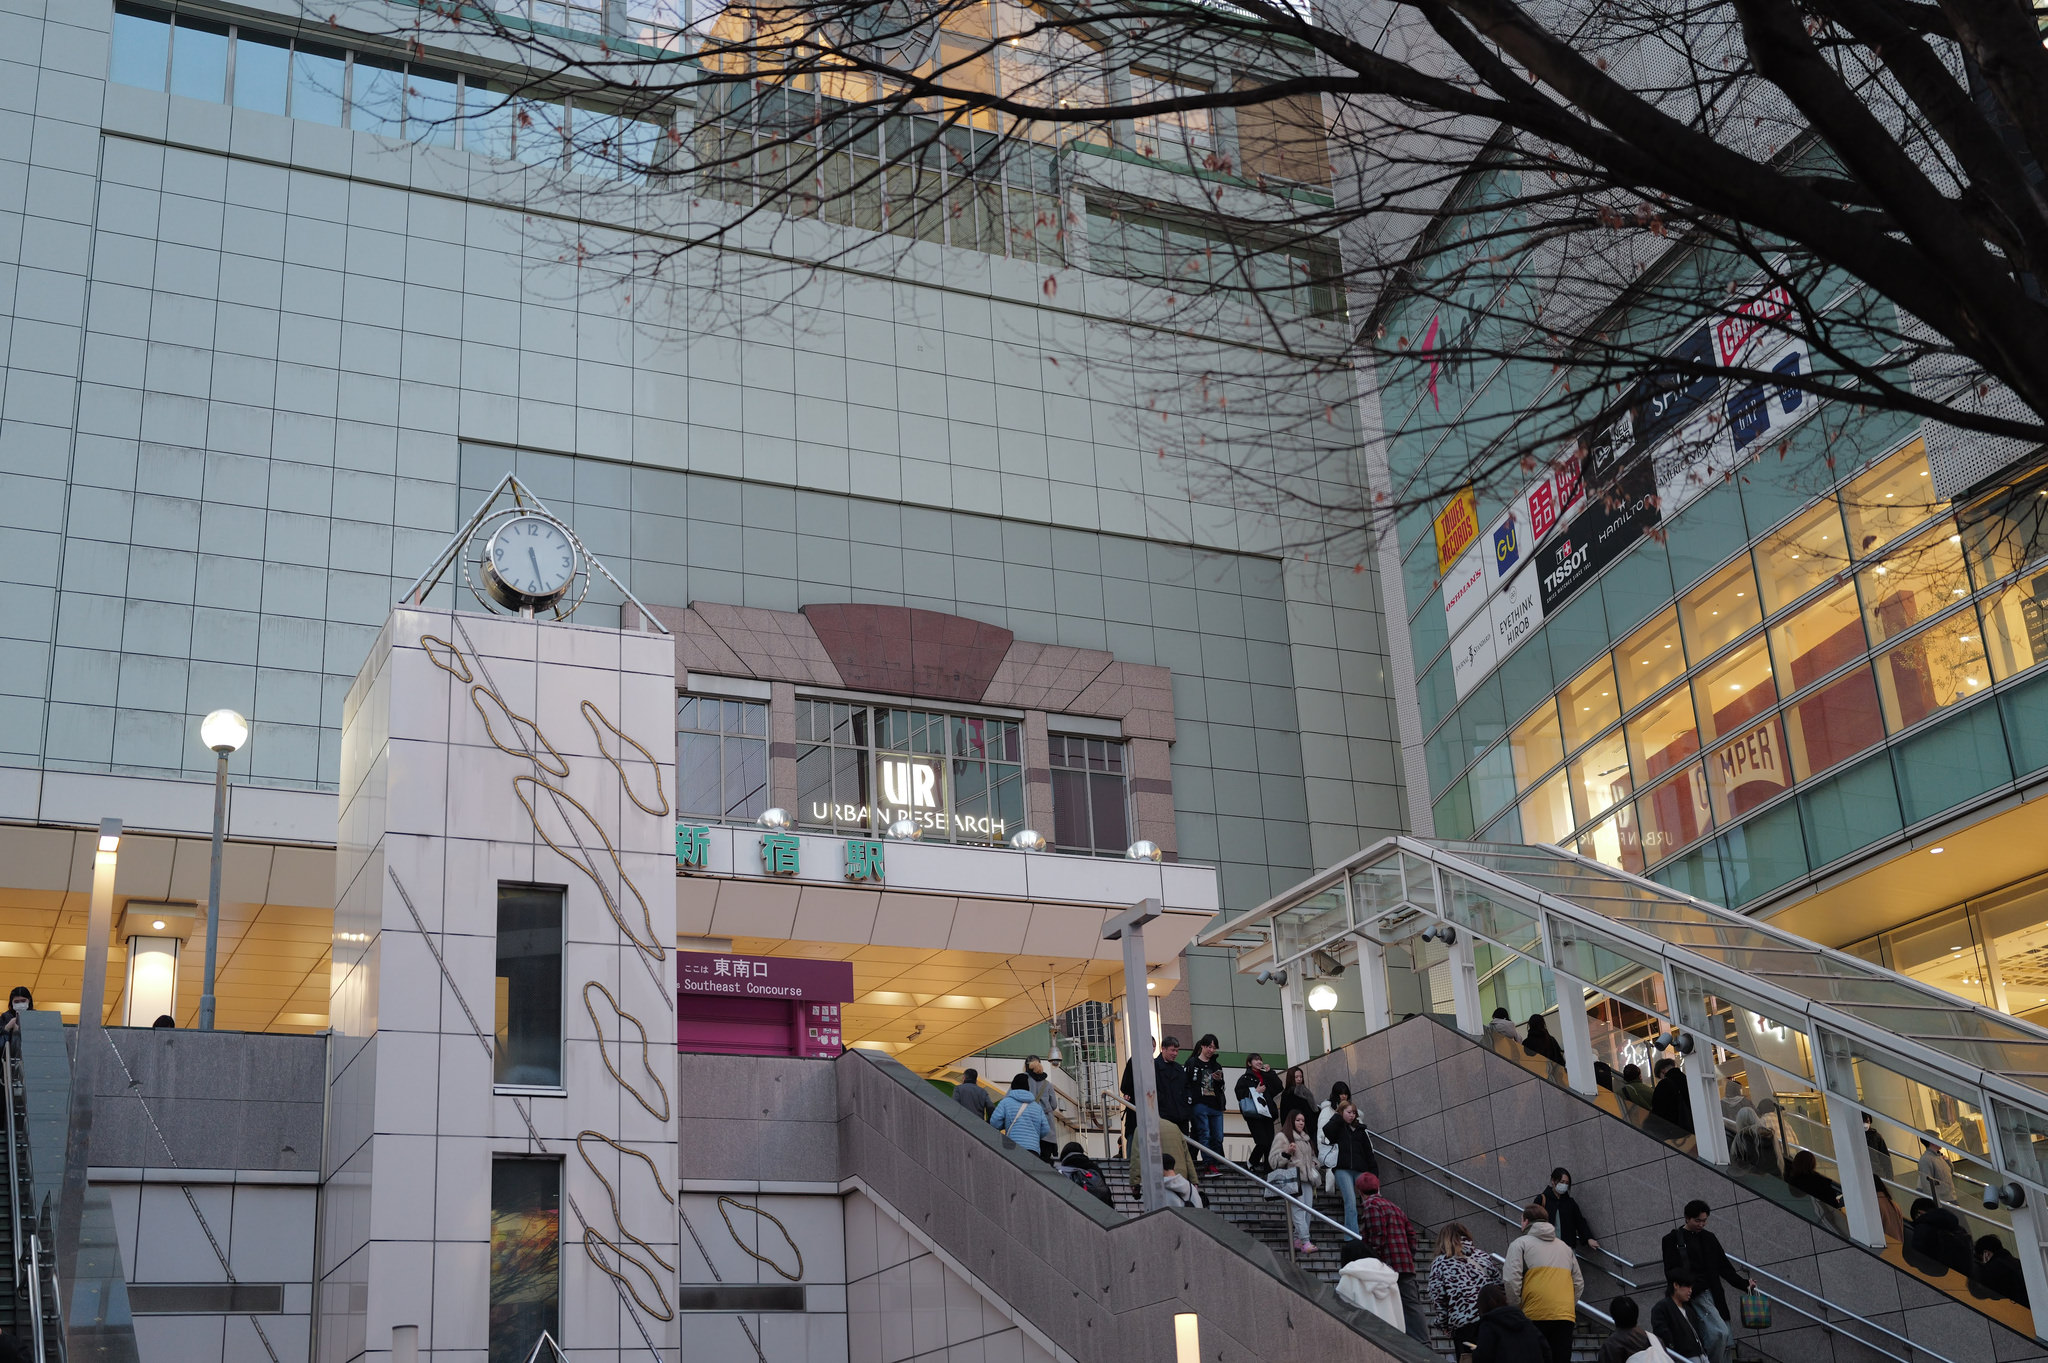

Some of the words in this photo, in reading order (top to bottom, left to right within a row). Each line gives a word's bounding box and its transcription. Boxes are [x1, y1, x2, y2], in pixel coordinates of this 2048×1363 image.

[528, 524, 538, 536] 12
[1441, 497, 1465, 539] TOWER
[495, 548, 504, 561] 9
[1441, 515, 1473, 566] RECORDS
[1497, 529, 1515, 561] GU
[562, 557, 570, 568] 3
[1544, 543, 1588, 593] TISSOT
[528, 580, 537, 593] 6
[1445, 568, 1482, 612] OSHMAN'S
[1499, 594, 1533, 635] EYETHINK
[1507, 616, 1530, 646] HIROB
[883, 760, 936, 808] UR
[1696, 725, 1775, 811] CMPER
[813, 801, 890, 825] URBAN
[898, 809, 1005, 835] RESEARCH
[676, 824, 884, 880] 新宿駅
[685, 965, 709, 974] ここは
[713, 958, 768, 978] 東南口
[684, 978, 741, 993] Southeast
[747, 982, 802, 997] Concourse
